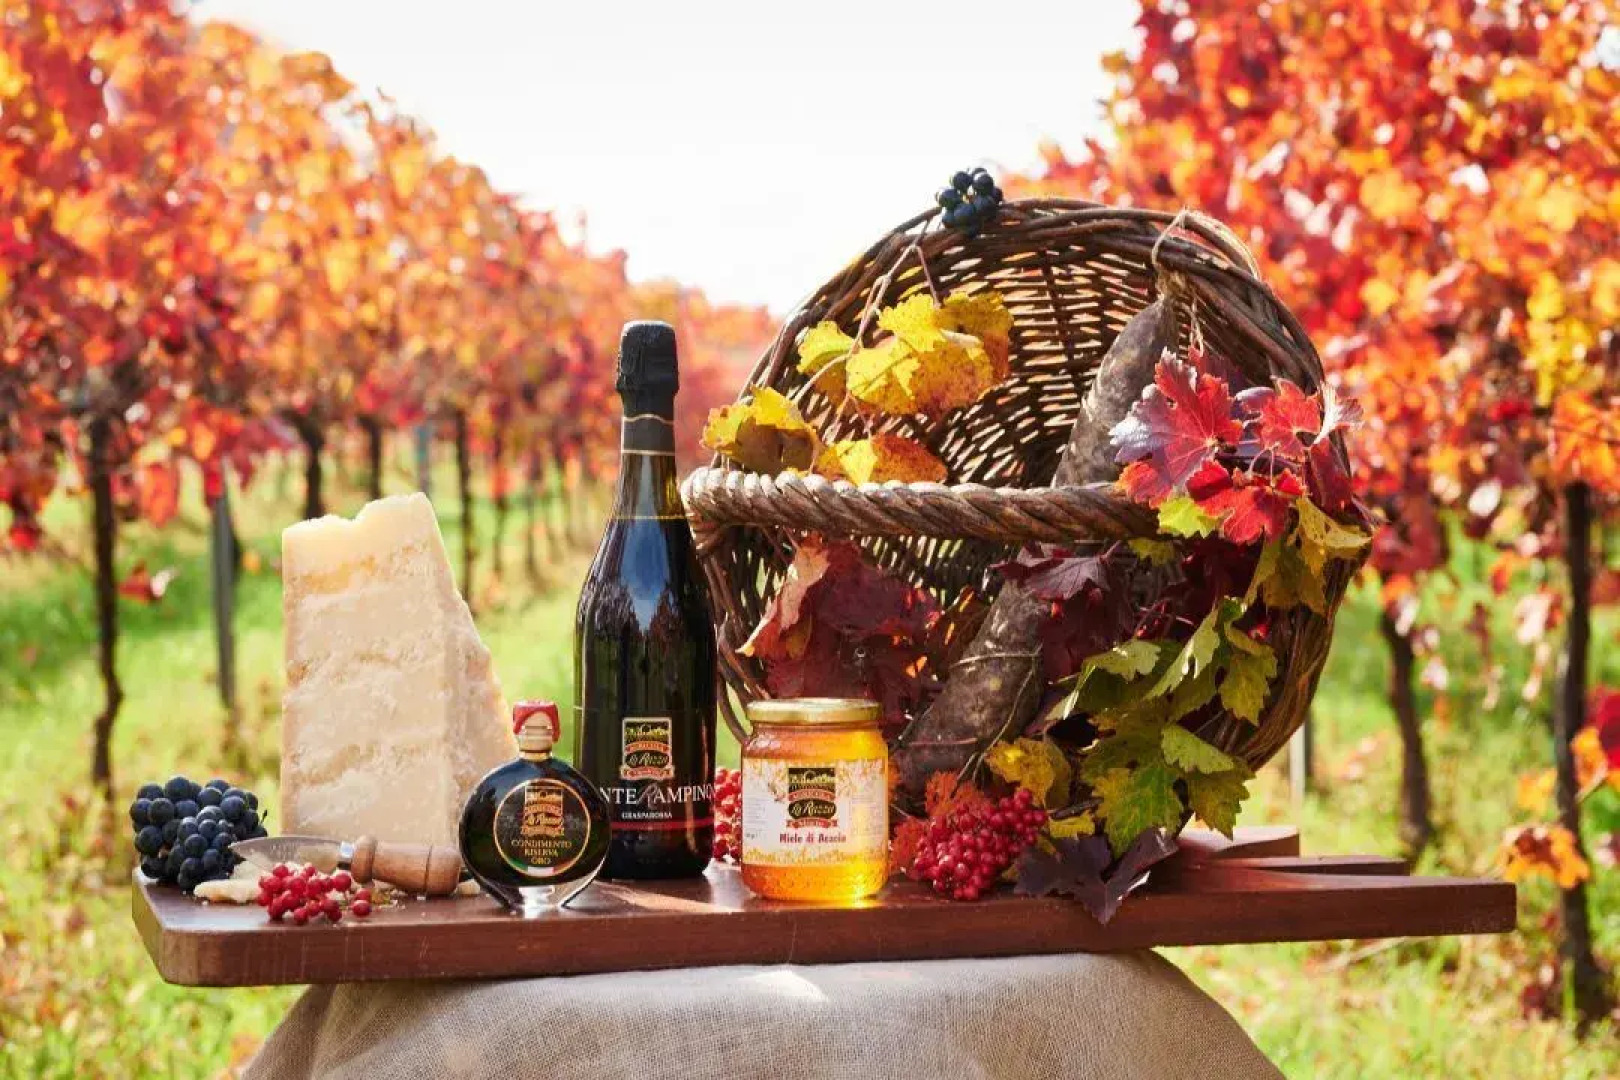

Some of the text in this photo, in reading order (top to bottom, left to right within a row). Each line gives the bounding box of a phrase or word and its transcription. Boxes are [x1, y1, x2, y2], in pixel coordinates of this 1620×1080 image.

[780, 833, 846, 843] Miele di Acacia
[511, 839, 572, 849] CONDIMENTO
[525, 848, 559, 857] RISERVA
[530, 857, 551, 865] ORO
